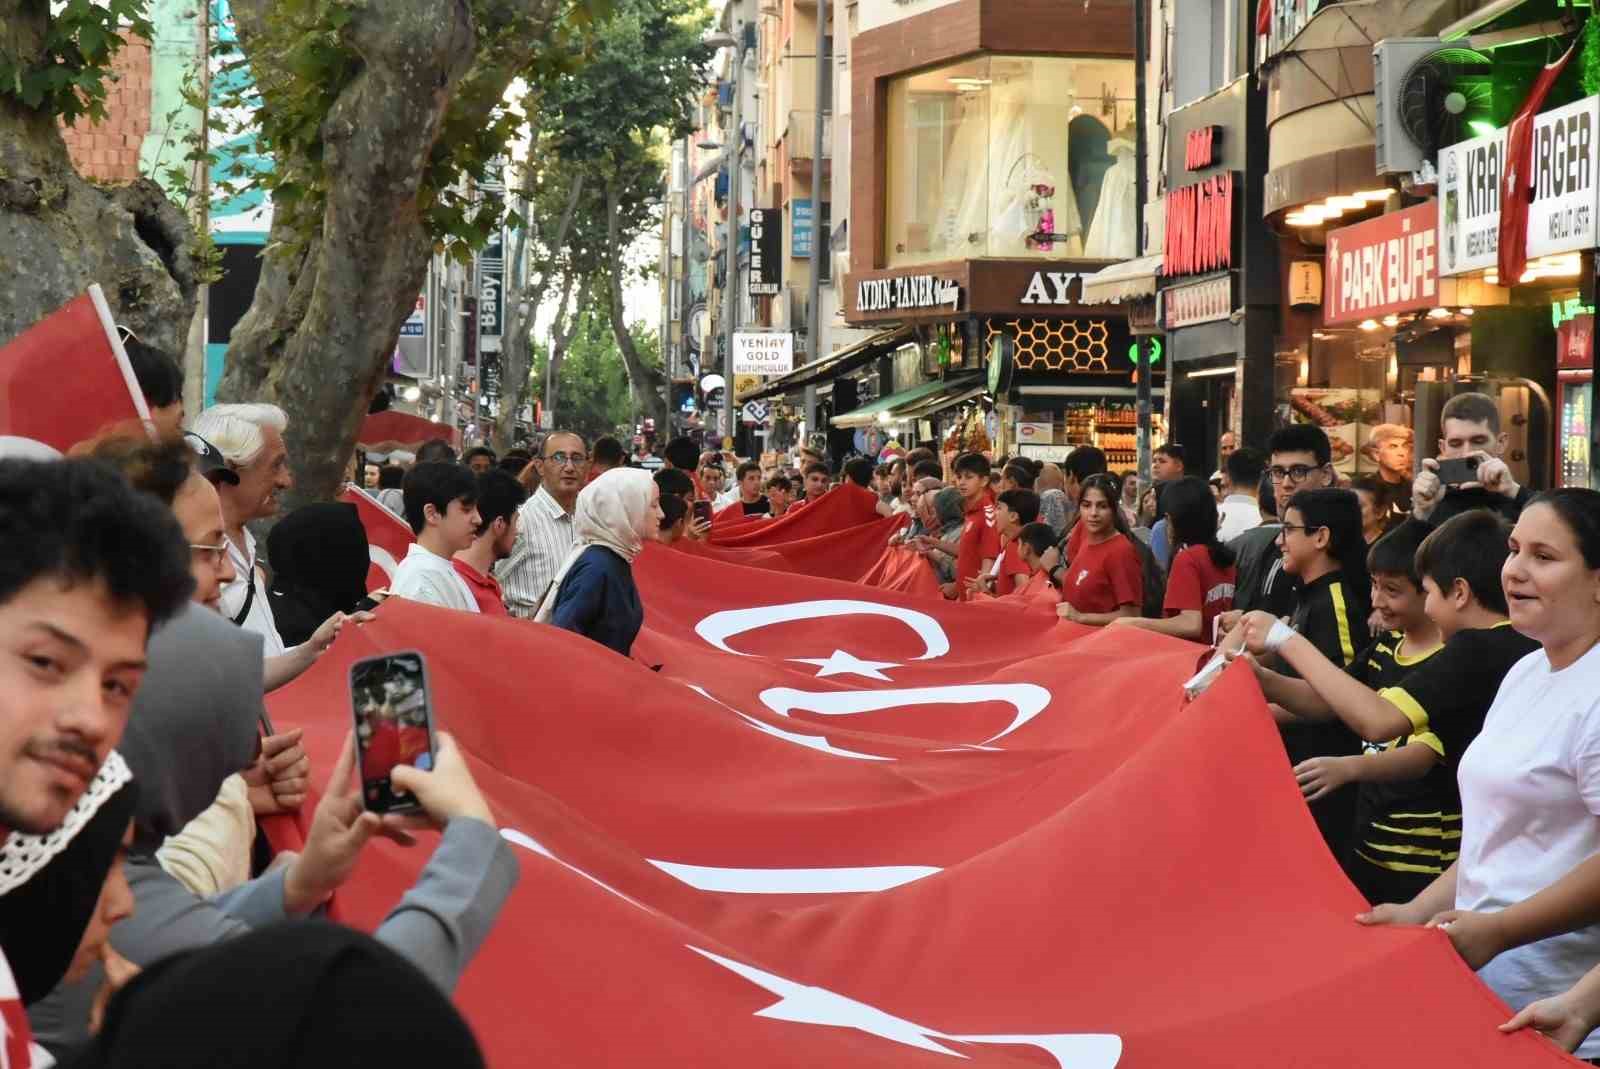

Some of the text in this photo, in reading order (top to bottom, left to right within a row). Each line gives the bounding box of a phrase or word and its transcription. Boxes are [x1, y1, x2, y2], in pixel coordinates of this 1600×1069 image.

[1529, 111, 1591, 204] URGER
[751, 210, 763, 282] GÜLER
[1341, 218, 1435, 312] PARK BÜFE
[481, 275, 501, 327] Baby
[746, 351, 779, 361] GOLD
